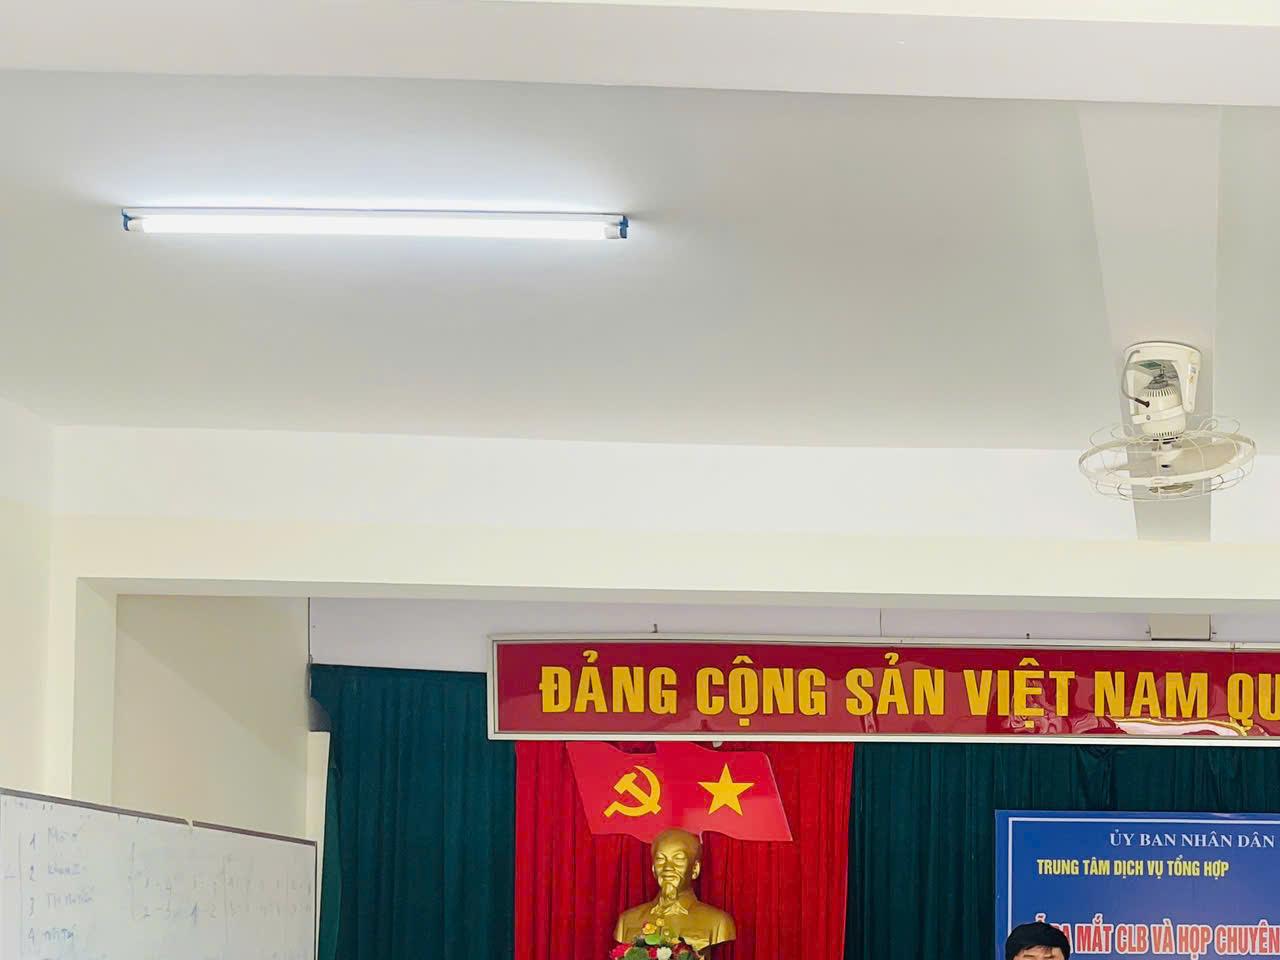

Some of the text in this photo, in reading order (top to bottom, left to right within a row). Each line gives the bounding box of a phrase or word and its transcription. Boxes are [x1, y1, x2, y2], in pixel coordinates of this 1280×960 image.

[539, 650, 677, 714] ĐẢNG
[697, 655, 826, 727] CỘNG
[845, 652, 946, 717] SẢN
[962, 658, 1074, 727] VIỆT
[1095, 670, 1205, 719] NAM
[1109, 829, 1134, 846] ỦY
[1140, 834, 1176, 846] BAN
[1181, 831, 1233, 848] NHÂN
[1238, 832, 1275, 848] DÂN
[1037, 855, 1229, 880] TRUNG TÂM DỊCH VỤ TỔNG HỢP
[1075, 913, 1114, 954] MẮT
[1115, 924, 1148, 954] CLB
[1152, 918, 1174, 954] VÀ
[1177, 924, 1212, 960] HỌP
[1215, 919, 1280, 955] CHUYÊN
